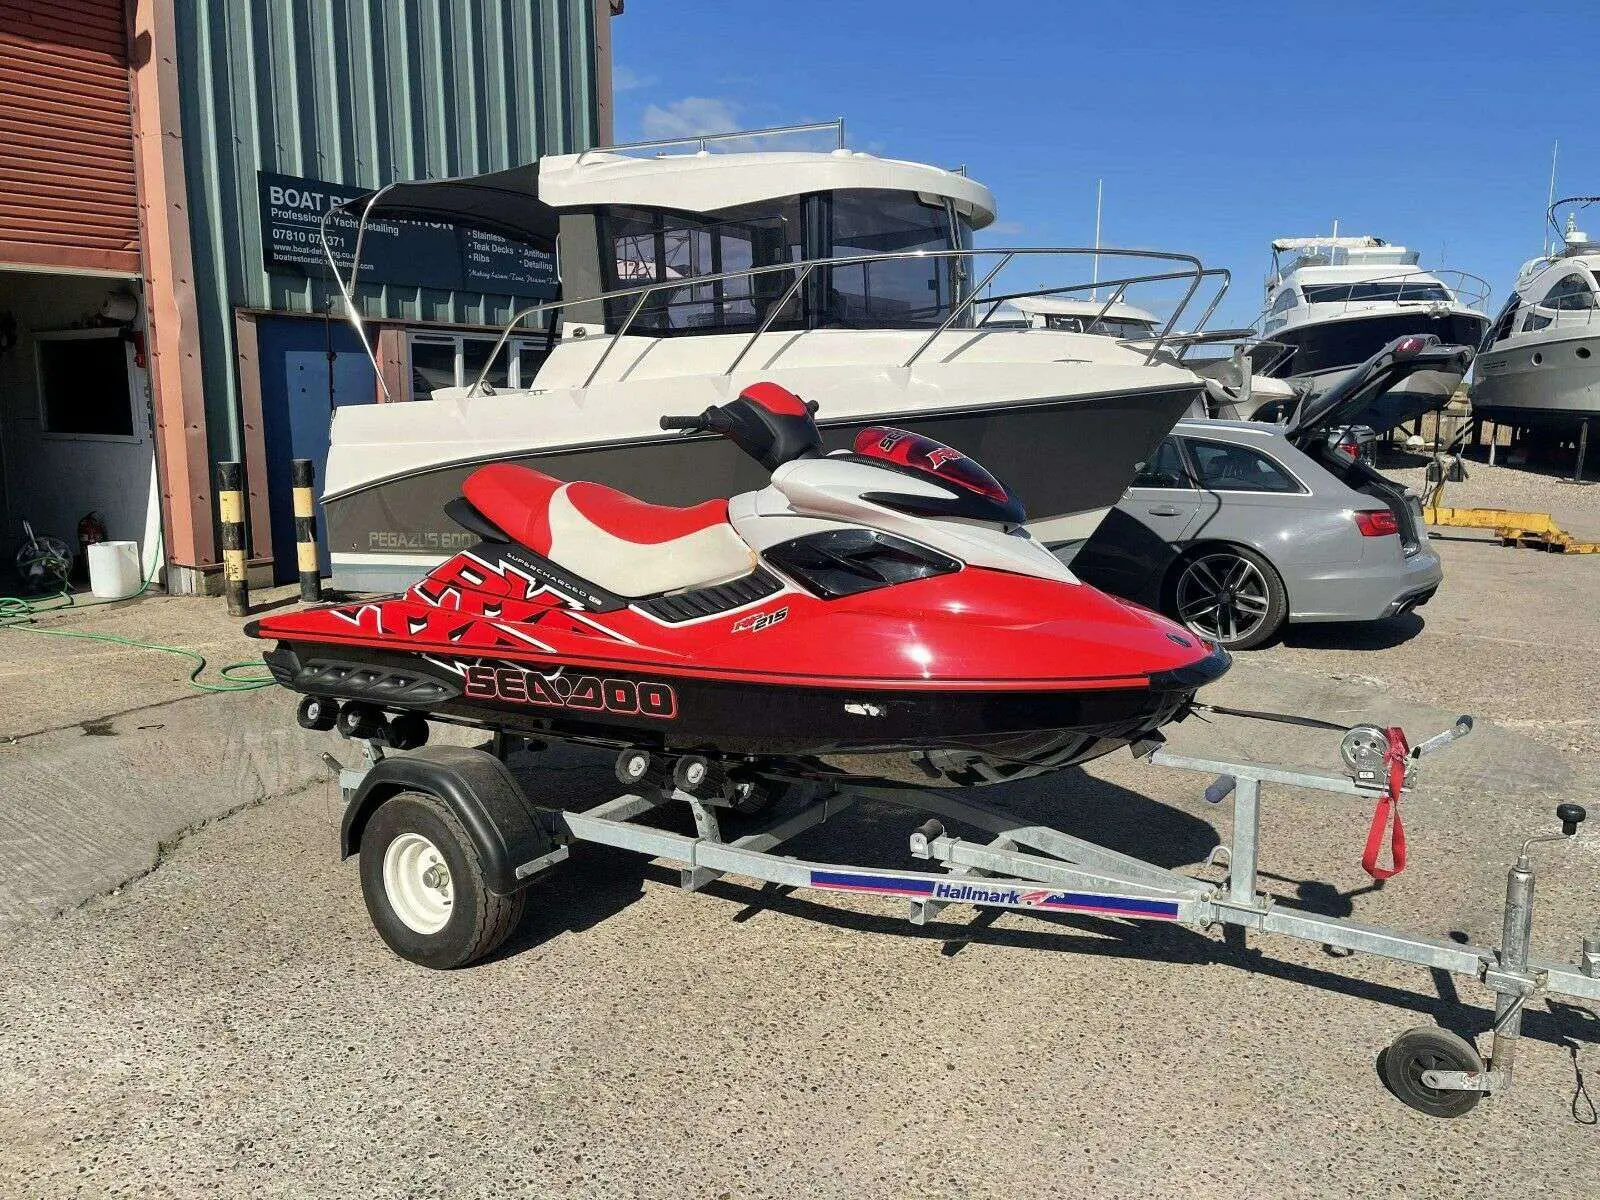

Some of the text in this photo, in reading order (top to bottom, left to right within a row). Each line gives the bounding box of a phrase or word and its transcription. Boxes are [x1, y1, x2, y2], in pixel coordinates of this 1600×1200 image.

[269, 186, 323, 211] BOAT
[334, 215, 359, 229] Yacht
[272, 229, 345, 247] 07810 07371
[473, 241, 514, 255] Teak Decks
[473, 253, 490, 263] Ribs
[523, 259, 553, 273] Detailing
[506, 551, 587, 598] SUPERCHARGED
[753, 606, 788, 633] 215
[936, 883, 1021, 905] Hallmark
